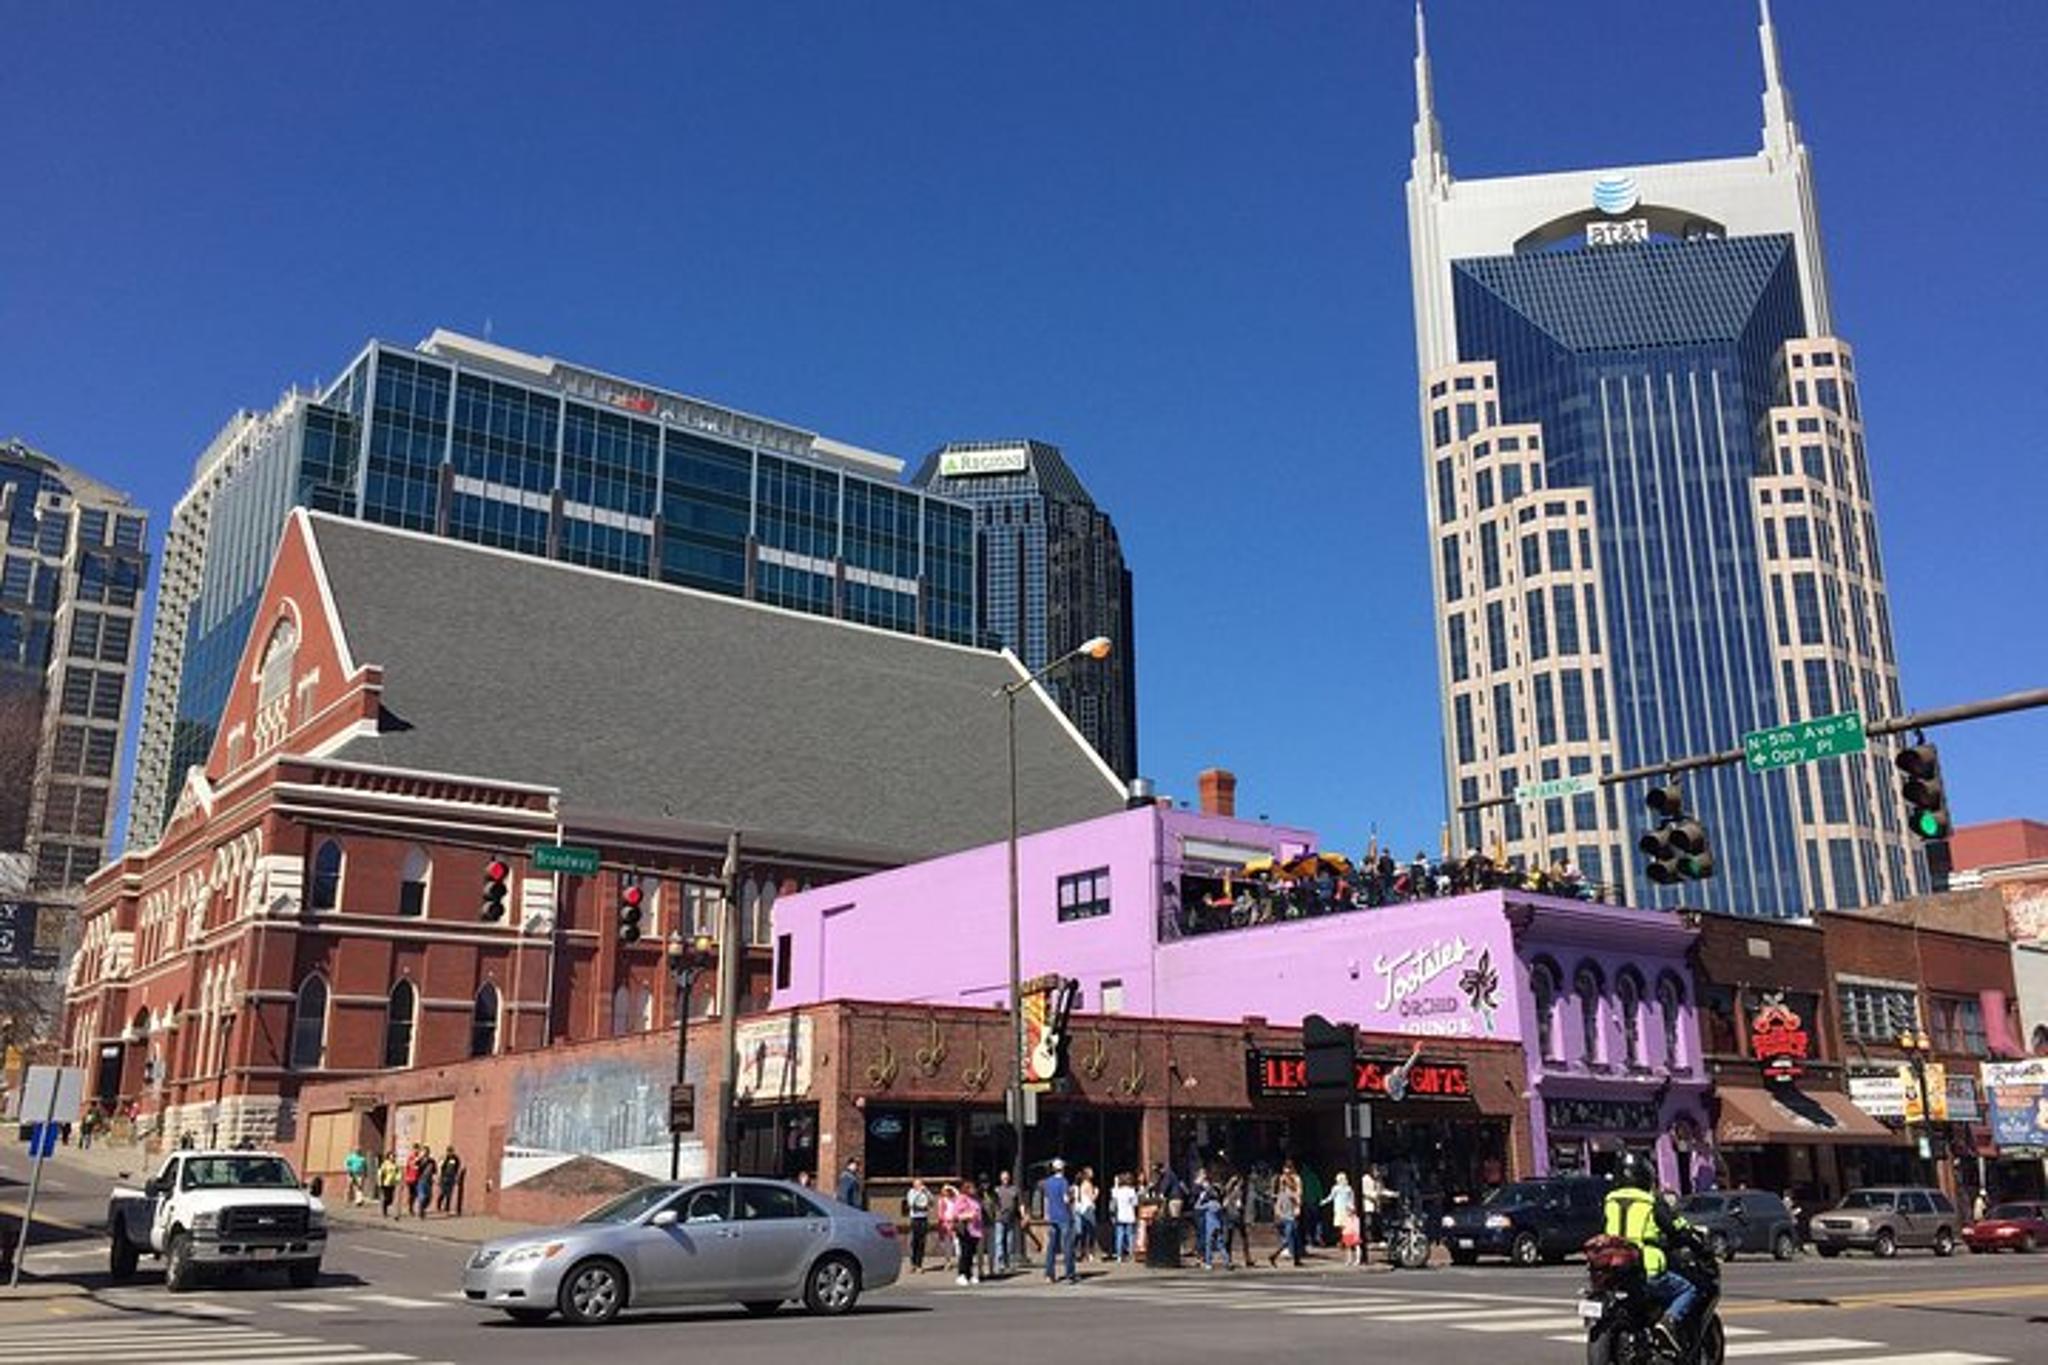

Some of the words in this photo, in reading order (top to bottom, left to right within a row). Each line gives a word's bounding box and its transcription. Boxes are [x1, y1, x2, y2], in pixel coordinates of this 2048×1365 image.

[1591, 219, 1645, 245] at&t
[1771, 746, 1806, 763] Opry
[1817, 739, 1833, 755] Pl
[537, 848, 594, 872] Broadway
[1400, 997, 1458, 1017] ORCHID
[1411, 1067, 1468, 1094] GIFTS
